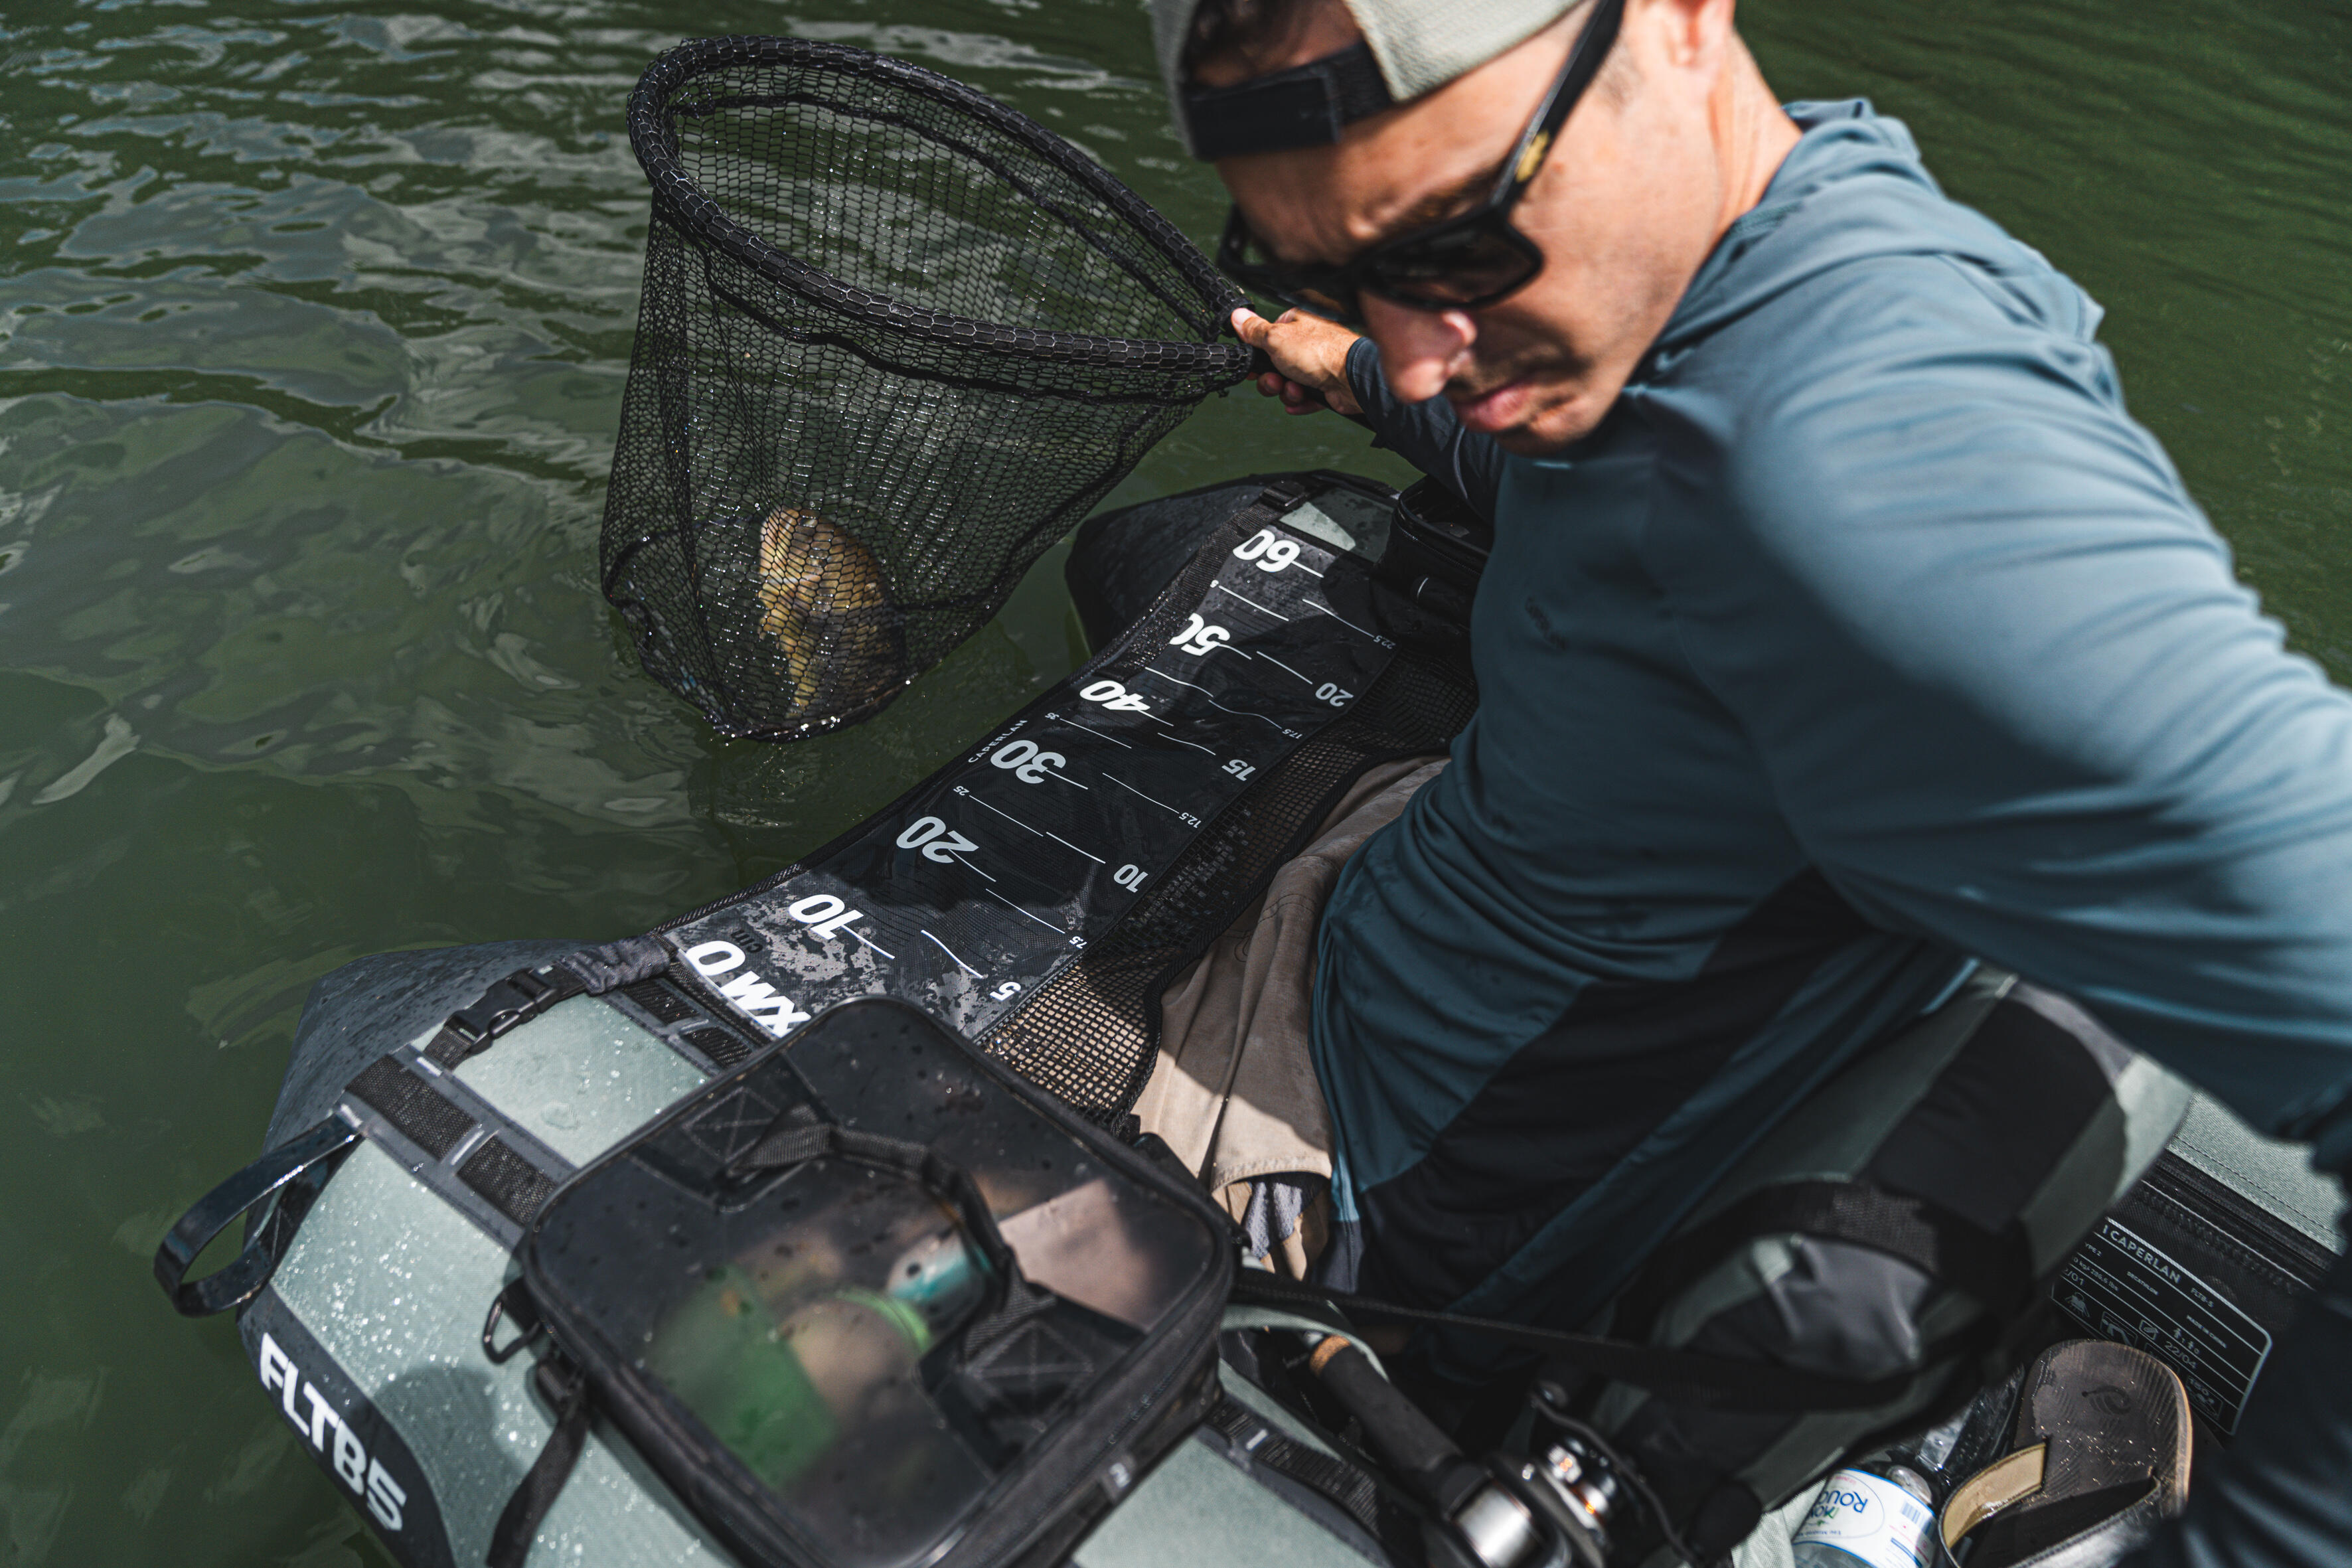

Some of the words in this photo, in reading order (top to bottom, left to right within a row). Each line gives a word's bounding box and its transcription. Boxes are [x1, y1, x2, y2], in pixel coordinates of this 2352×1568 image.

[1233, 530, 1300, 572] 60
[1080, 680, 1150, 710] 40
[1315, 682, 1354, 707] 20
[968, 720, 1028, 763] CAPERLAN
[1281, 728, 1304, 740] 17.5
[990, 740, 1066, 783] 30
[1221, 759, 1256, 781] 15
[953, 786, 969, 796] 25
[1179, 812, 1202, 828] 12.5
[896, 816, 979, 863] 20
[1114, 864, 1148, 893] 10
[788, 894, 863, 939] 10
[990, 982, 1022, 1001] 5
[2110, 1230, 2181, 1284] CAPERLAN
[2164, 1341, 2197, 1369] 22/04
